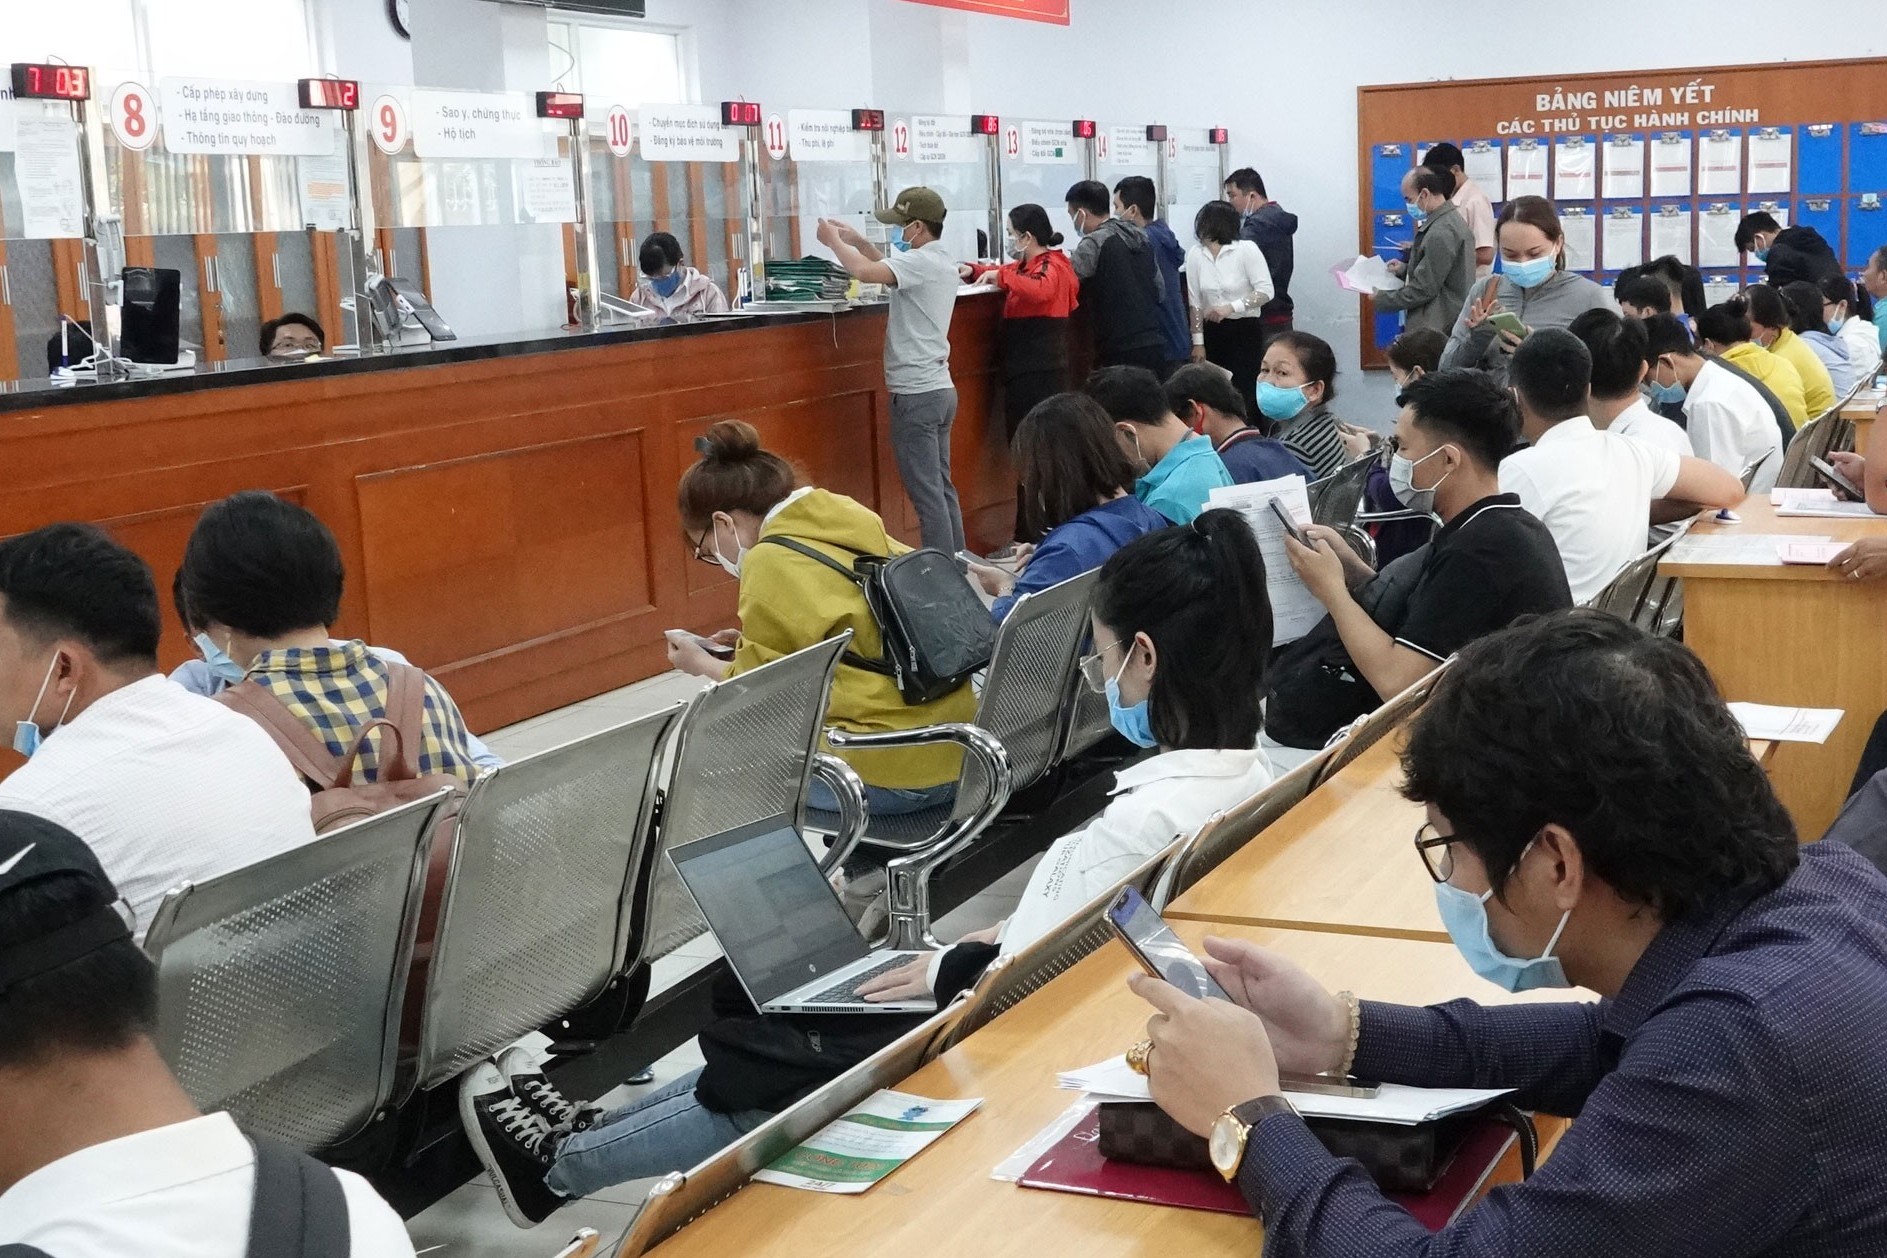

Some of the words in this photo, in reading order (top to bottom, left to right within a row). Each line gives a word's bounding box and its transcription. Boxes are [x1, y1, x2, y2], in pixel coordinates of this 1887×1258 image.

[182, 84, 201, 101] Cấp
[228, 88, 244, 103] xây
[1536, 86, 1597, 111] BẢNG
[1604, 86, 1662, 107] NIÊM
[1670, 78, 1715, 104] YẾT
[123, 93, 146, 137] 8
[222, 110, 242, 125] giao
[243, 110, 269, 126] thông
[380, 104, 397, 143] 9
[441, 105, 460, 118] Sao
[1496, 117, 1535, 134] CÁC
[1541, 112, 1580, 132] THỦ
[1588, 115, 1627, 133] TỤC
[1634, 109, 1689, 127] HÀNH
[1696, 106, 1759, 124] CHÍNH
[186, 131, 217, 147] Thông
[218, 132, 230, 144] tin
[231, 135, 249, 147] quy
[443, 127, 457, 140] Hộ
[610, 114, 629, 146] 10
[769, 121, 783, 151] 11
[895, 127, 908, 154] 12
[1007, 129, 1018, 155] 13
[1098, 135, 1107, 158] 14
[1168, 137, 1176, 158] 15
